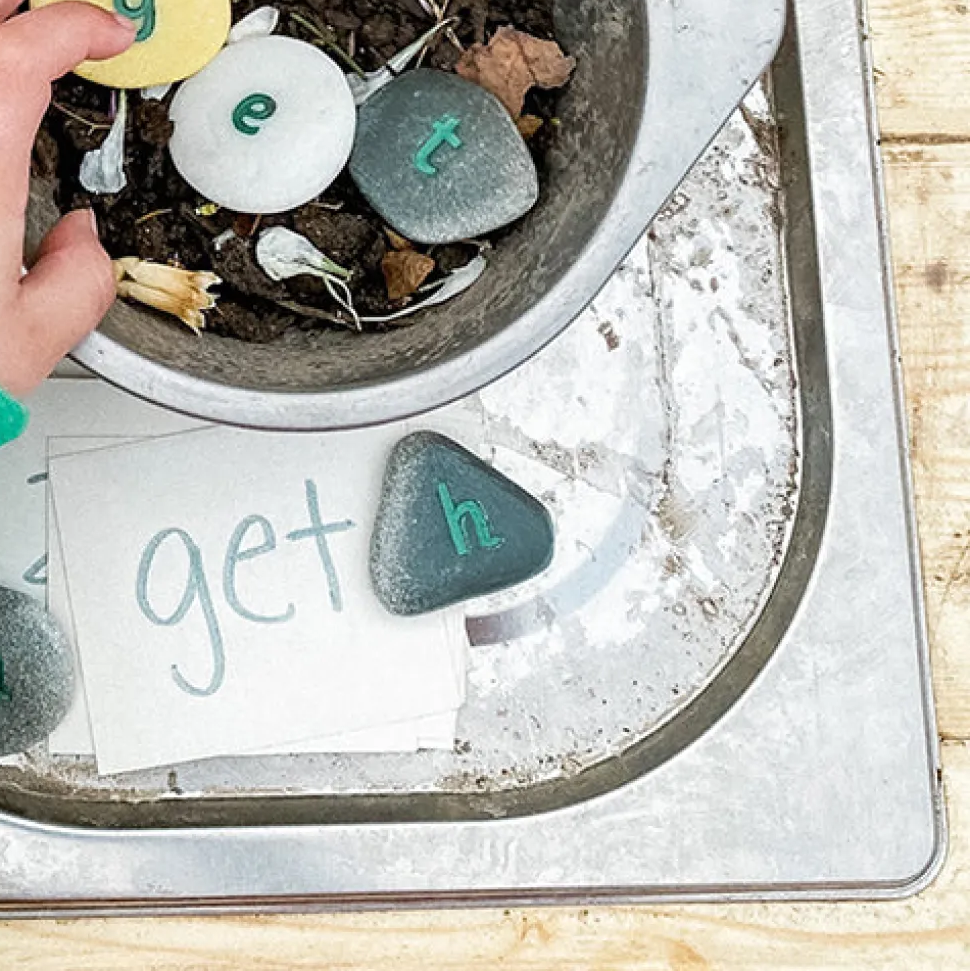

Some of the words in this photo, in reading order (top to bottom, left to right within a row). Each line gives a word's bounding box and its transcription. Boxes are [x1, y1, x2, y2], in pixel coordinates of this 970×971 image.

[230, 92, 275, 137] e
[412, 111, 463, 177] t
[437, 481, 504, 556] h
[136, 478, 357, 697] get
